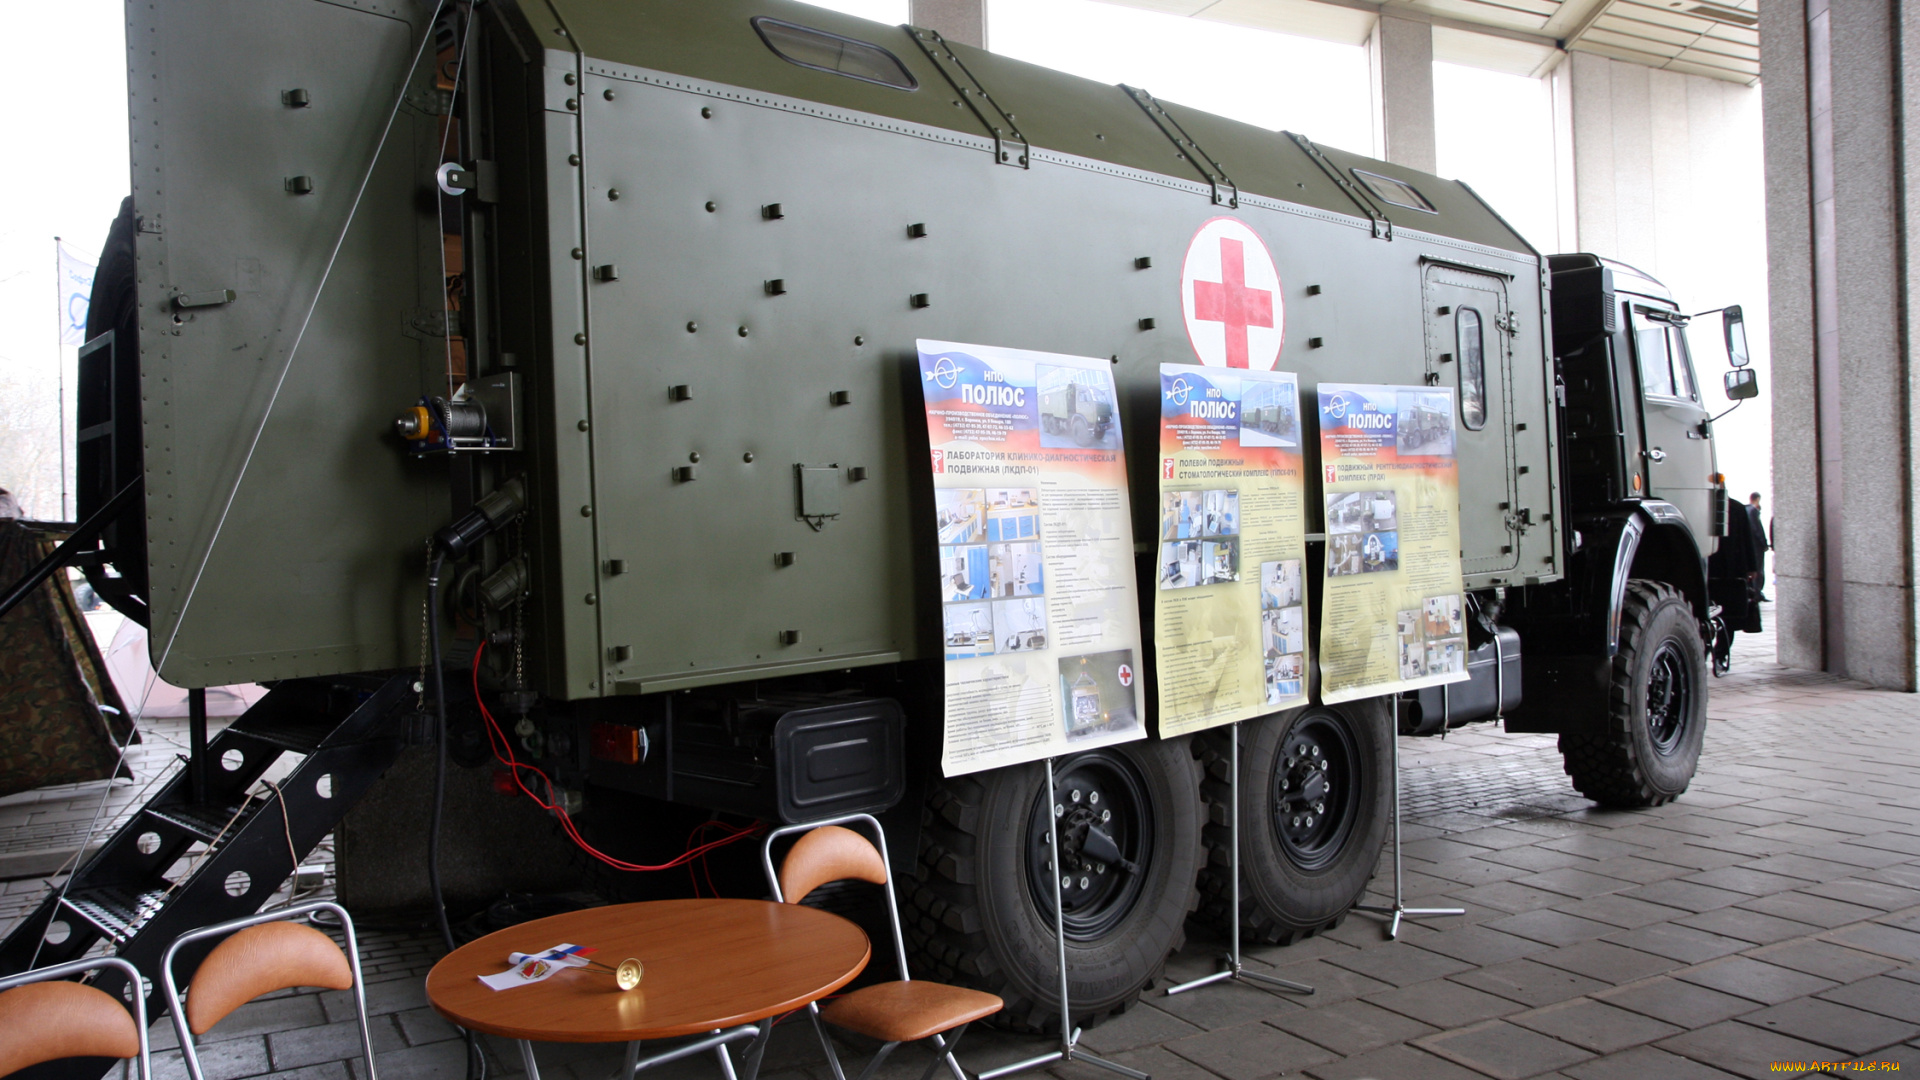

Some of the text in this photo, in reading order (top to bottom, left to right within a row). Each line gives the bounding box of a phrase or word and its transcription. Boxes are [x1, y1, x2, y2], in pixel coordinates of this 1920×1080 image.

[983, 370, 1004, 383] НПО
[961, 383, 1025, 407] ПОЛЮС
[1206, 388, 1222, 398] НПО
[1190, 400, 1236, 419] ПОЛЮС
[1363, 403, 1377, 412] НПО
[1348, 413, 1392, 429] ПОЛЮС
[947, 451, 1116, 463] ЛАБОРАТОРИЯ КЛИНИКО-ДИАГНОСТИЧЕСКАЯ
[1179, 458, 1244, 467] ПОЛЕВОЙ ПОДВИЖНЫЙ
[1337, 462, 1453, 472] ПОДВИЖНЫЙ РЕНТГЕНОДИАГНОСТИЧЕСКИЙ
[947, 465, 1039, 475] ПОДВИЖНАЯ (ЛКДП-01)
[1179, 469, 1242, 479] СТОМАТОЛОГИЧЕСКИЙ
[1243, 469, 1269, 478] КОМПЛЕКС
[1338, 473, 1386, 482] КОМПЛЕКС (ПРДК)
